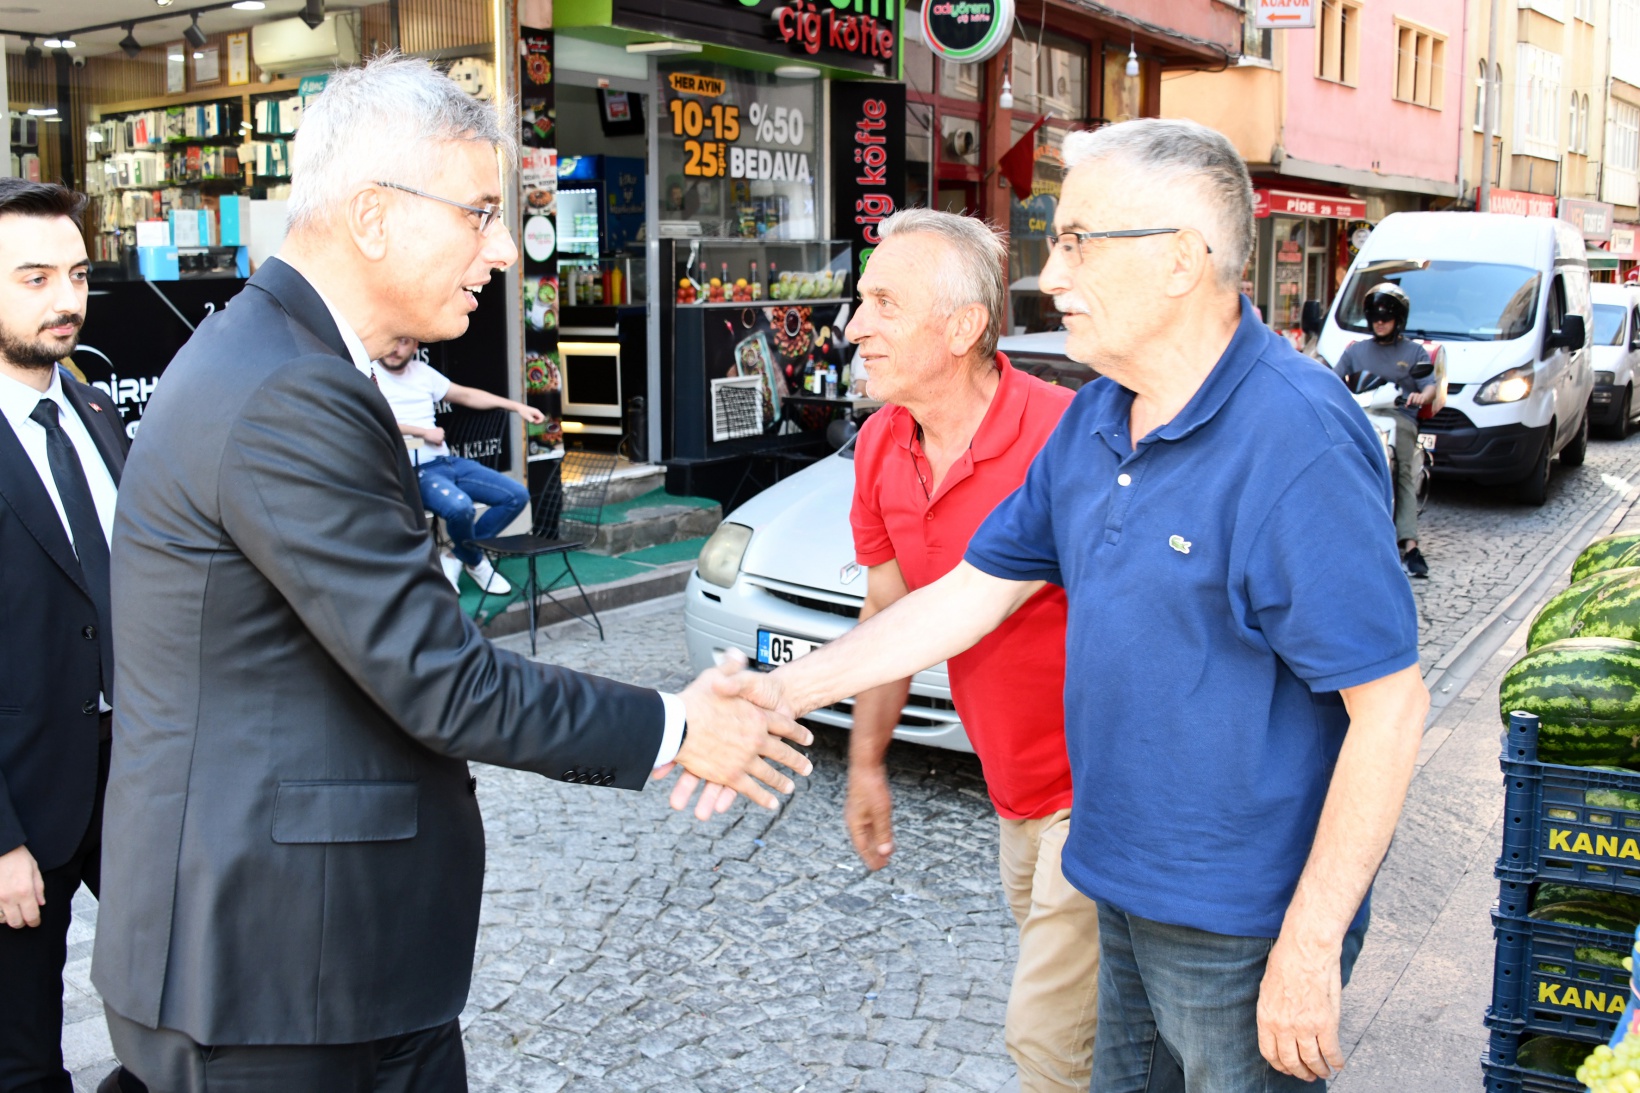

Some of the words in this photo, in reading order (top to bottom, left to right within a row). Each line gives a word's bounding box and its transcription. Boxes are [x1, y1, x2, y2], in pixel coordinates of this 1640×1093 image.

[776, 0, 821, 54] çiğ
[825, 8, 894, 59] köfte
[674, 76, 695, 90] HER
[697, 78, 722, 93] AYIN
[670, 99, 740, 141] 10-15
[749, 102, 804, 146] %50
[684, 139, 718, 178] 25
[854, 98, 887, 185] köfte
[730, 146, 811, 183] BEDAVA
[1287, 198, 1316, 214] PİDE
[771, 637, 794, 663] 05
[1549, 827, 1640, 861] KANA
